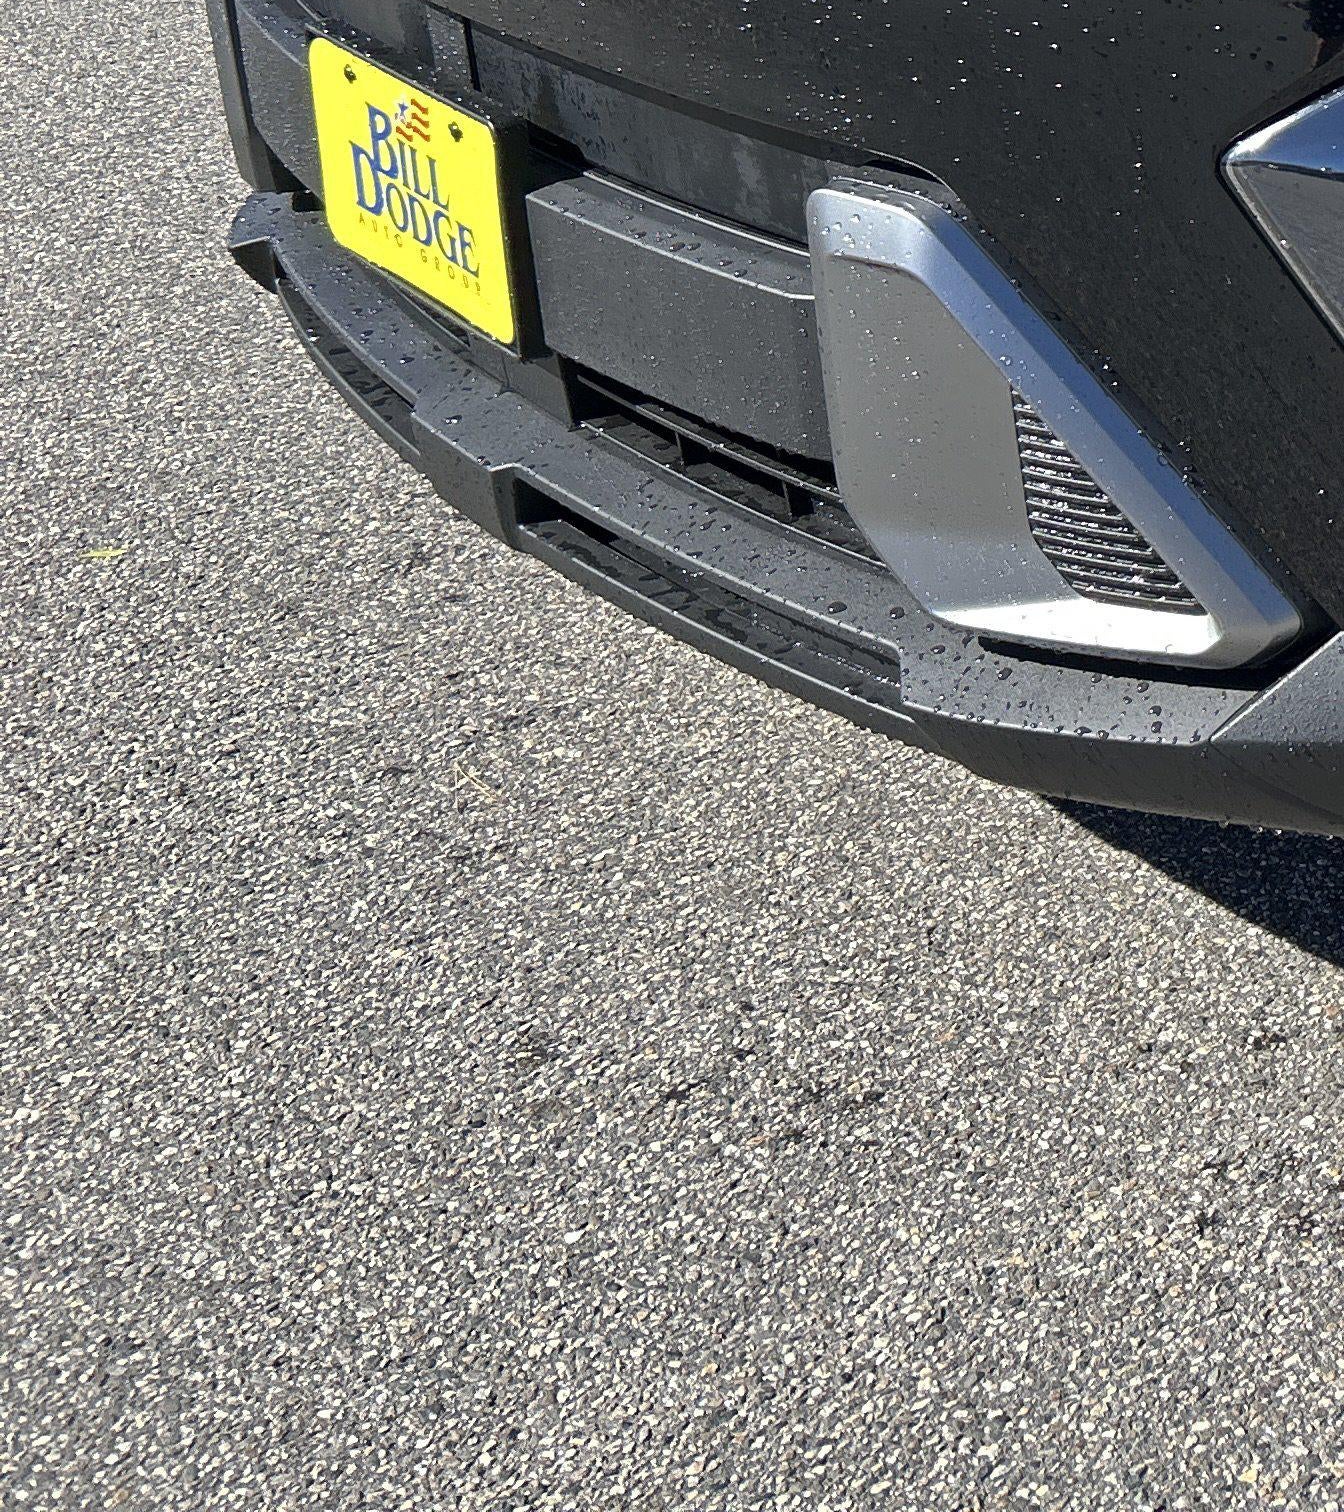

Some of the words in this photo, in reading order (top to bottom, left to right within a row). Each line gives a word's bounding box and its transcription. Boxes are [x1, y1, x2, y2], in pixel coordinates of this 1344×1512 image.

[348, 139, 480, 279] DODGE
[364, 101, 450, 212] BILL
[359, 212, 404, 248] AUTO
